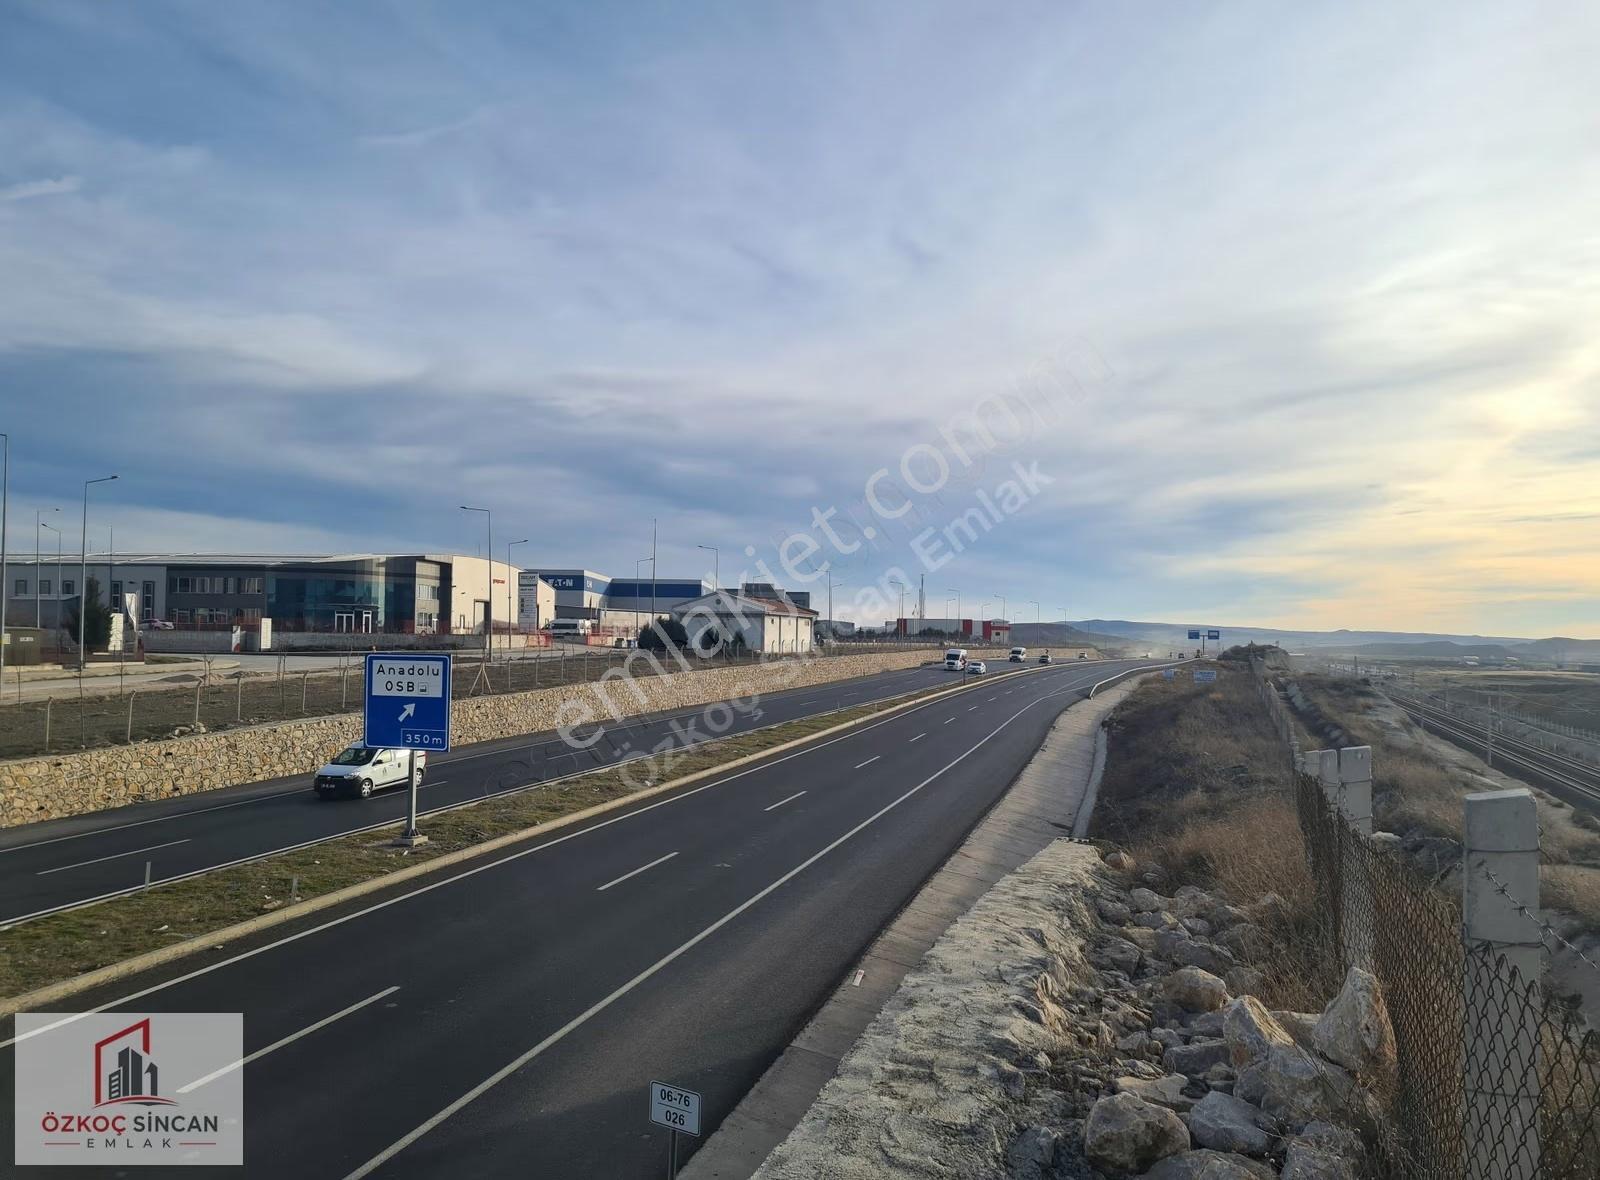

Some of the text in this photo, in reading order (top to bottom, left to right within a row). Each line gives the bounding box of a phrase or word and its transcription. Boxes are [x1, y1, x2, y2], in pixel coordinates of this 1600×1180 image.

[377, 664, 439, 676] Anadolu
[385, 681, 415, 692] OSB
[406, 734, 429, 743] 350
[660, 1089, 690, 1106] 06-76
[665, 1110, 685, 1125] 026
